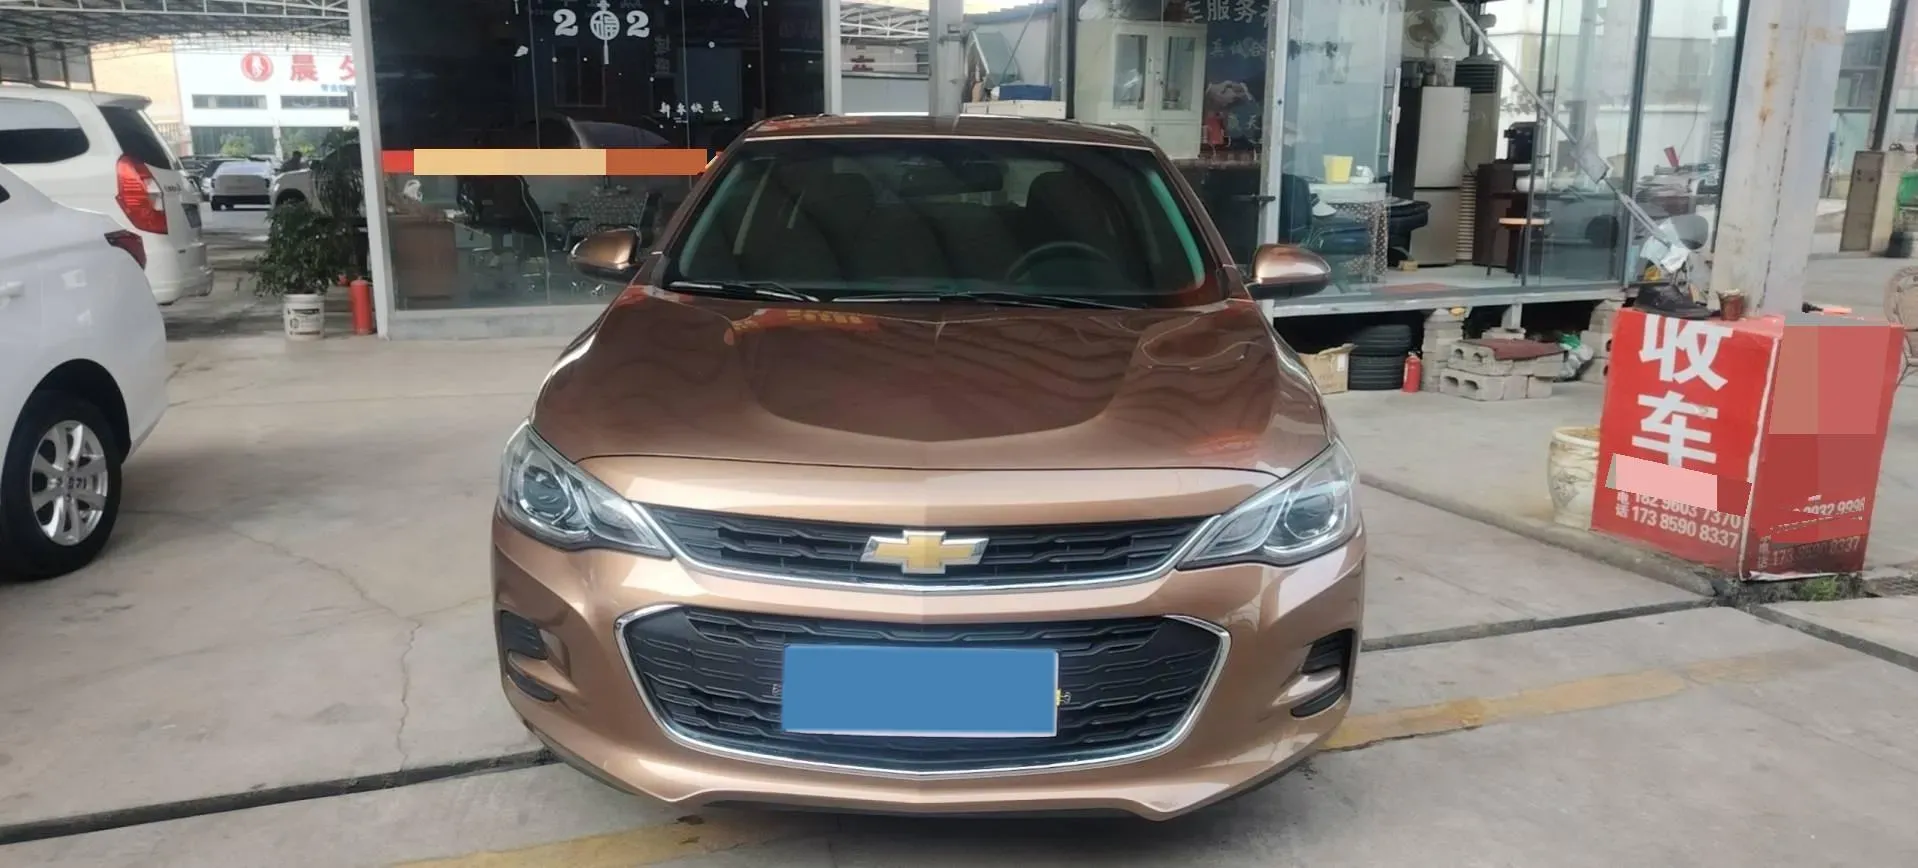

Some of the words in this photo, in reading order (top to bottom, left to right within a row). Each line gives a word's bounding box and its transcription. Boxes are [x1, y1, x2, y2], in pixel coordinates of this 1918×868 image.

[1632, 313, 1734, 467] 收车
[1632, 506, 1658, 527] 173
[1659, 513, 1697, 537] 8590
[1699, 524, 1740, 549] 8337
